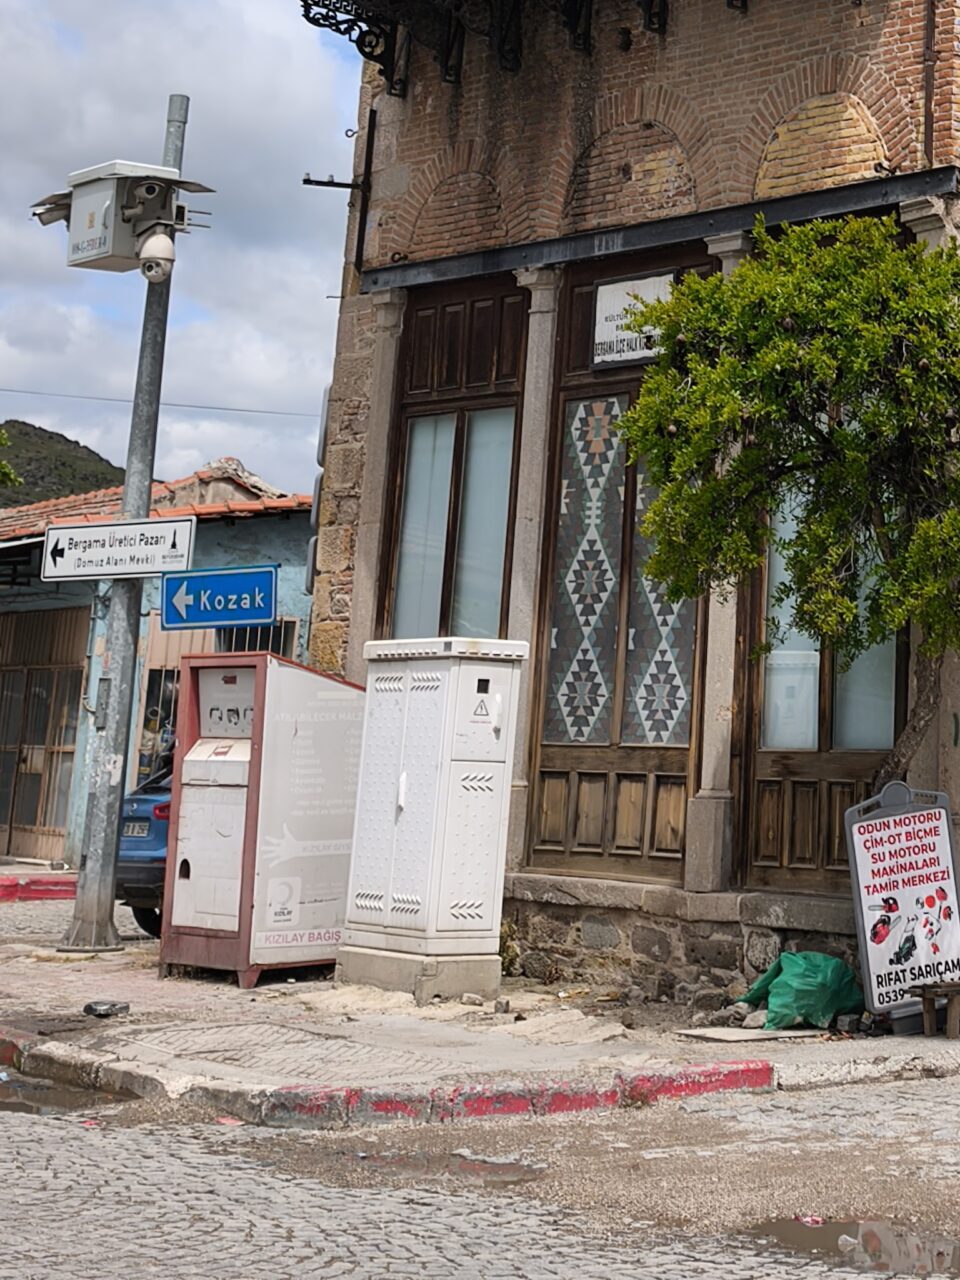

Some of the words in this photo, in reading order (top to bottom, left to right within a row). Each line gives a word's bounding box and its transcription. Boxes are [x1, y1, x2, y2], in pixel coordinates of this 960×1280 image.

[68, 537, 106, 553] Bergama
[108, 531, 137, 548] Üretici
[138, 533, 166, 546] Pazarı
[74, 557, 104, 571] (Domuz
[105, 554, 127, 567] Alanı
[129, 553, 156, 567] Mevki)
[200, 586, 265, 612] Kozak
[858, 820, 891, 835] ODUN
[893, 811, 942, 830] MOTORU
[863, 833, 902, 853] ÇİM-OT
[905, 826, 941, 844] BİÇME
[871, 852, 886, 864] SU
[888, 842, 936, 861] MOTORU
[871, 856, 940, 880] MAKİNALARI
[864, 879, 900, 896] TAMİR
[902, 866, 951, 889] MERKEZİ
[264, 932, 306, 945] KIZILAY
[308, 930, 342, 943] BAĞIŞ
[876, 968, 907, 989] RIFAT
[877, 988, 905, 1005] 0539
